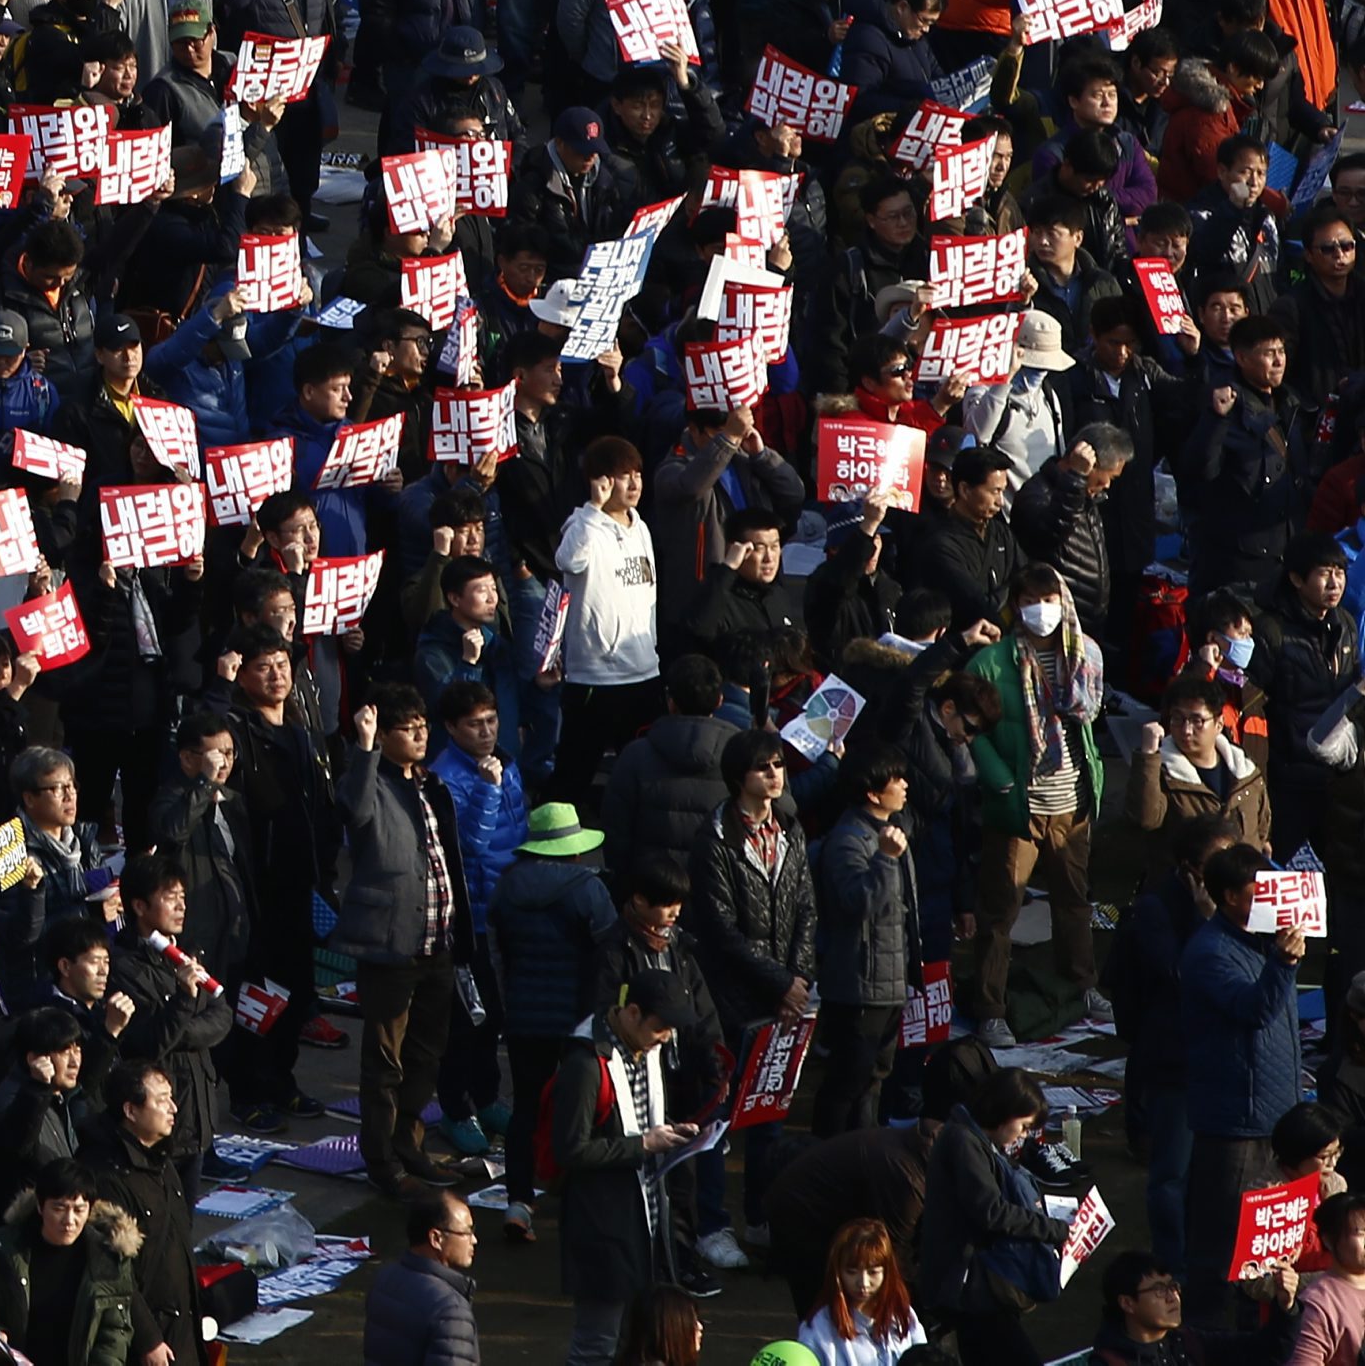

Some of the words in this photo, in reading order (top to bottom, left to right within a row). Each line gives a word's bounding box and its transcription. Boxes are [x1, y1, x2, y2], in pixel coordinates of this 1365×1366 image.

[756, 55, 848, 107] 내려와
[101, 129, 171, 174] 내려와
[593, 242, 647, 265] 끝내자
[931, 233, 1025, 278] 내려와
[923, 314, 1018, 359] 내려와
[433, 380, 517, 429] 내려와
[206, 434, 292, 490] 내려와
[102, 488, 203, 535] 내려와
[104, 525, 204, 570] 박근혜
[305, 556, 379, 604] 내려와
[1255, 873, 1319, 907] 박근혜
[1254, 1197, 1309, 1231] 박근혜는
[1251, 1222, 1305, 1255] 하야하라
